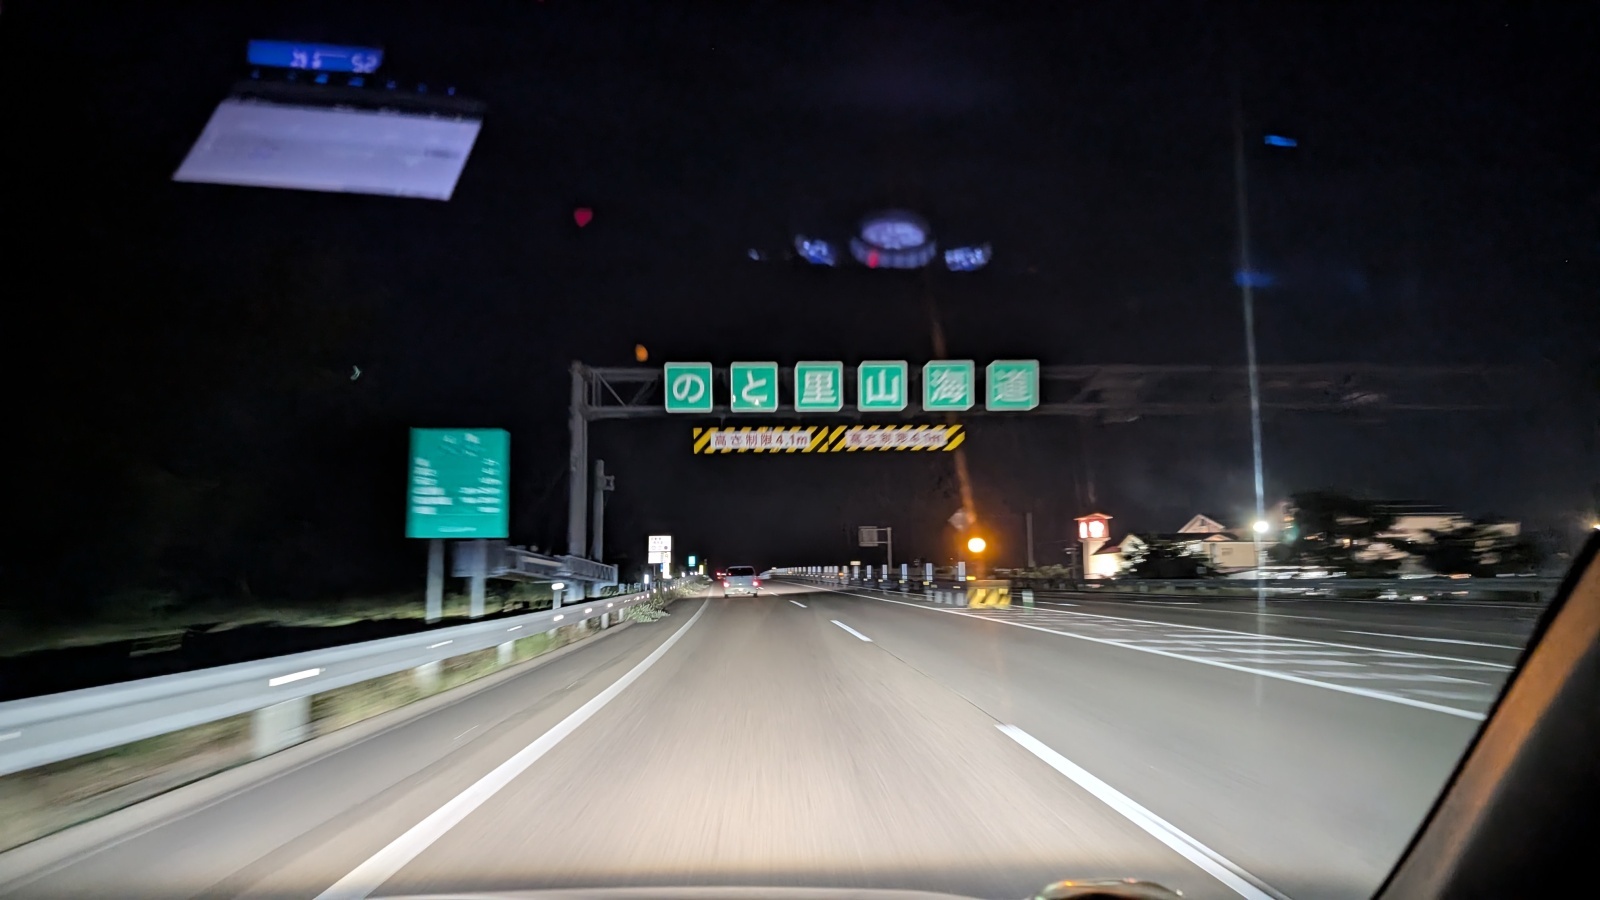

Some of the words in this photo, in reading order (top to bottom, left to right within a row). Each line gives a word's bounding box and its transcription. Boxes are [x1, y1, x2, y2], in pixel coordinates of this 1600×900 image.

[672, 369, 1032, 404] のと里山海道
[714, 434, 808, 446] 高さ制限4.1m
